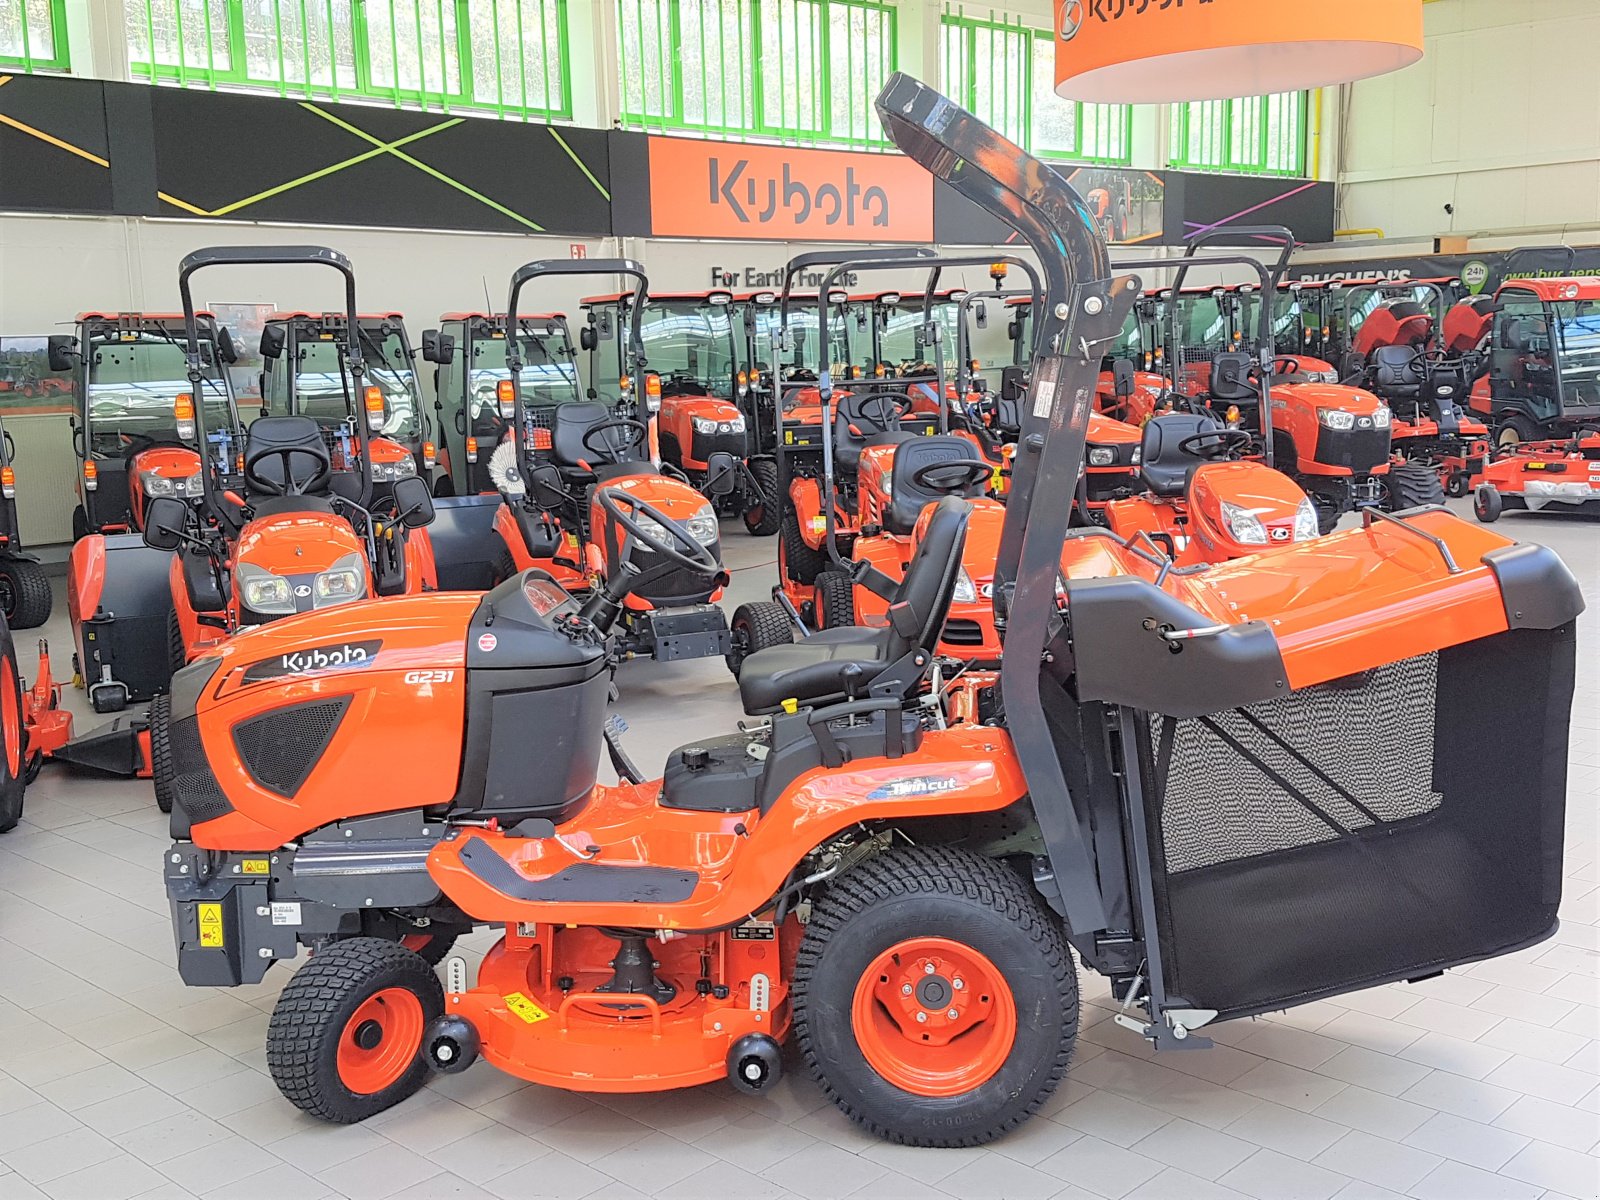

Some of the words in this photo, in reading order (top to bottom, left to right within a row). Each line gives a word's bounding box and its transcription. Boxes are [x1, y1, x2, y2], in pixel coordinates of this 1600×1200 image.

[709, 157, 888, 227] Kubota
[711, 266, 740, 287] For
[799, 267, 823, 287] For
[1467, 267, 1484, 275] 24h
[283, 645, 367, 671] Kubota
[404, 671, 455, 684] G231
